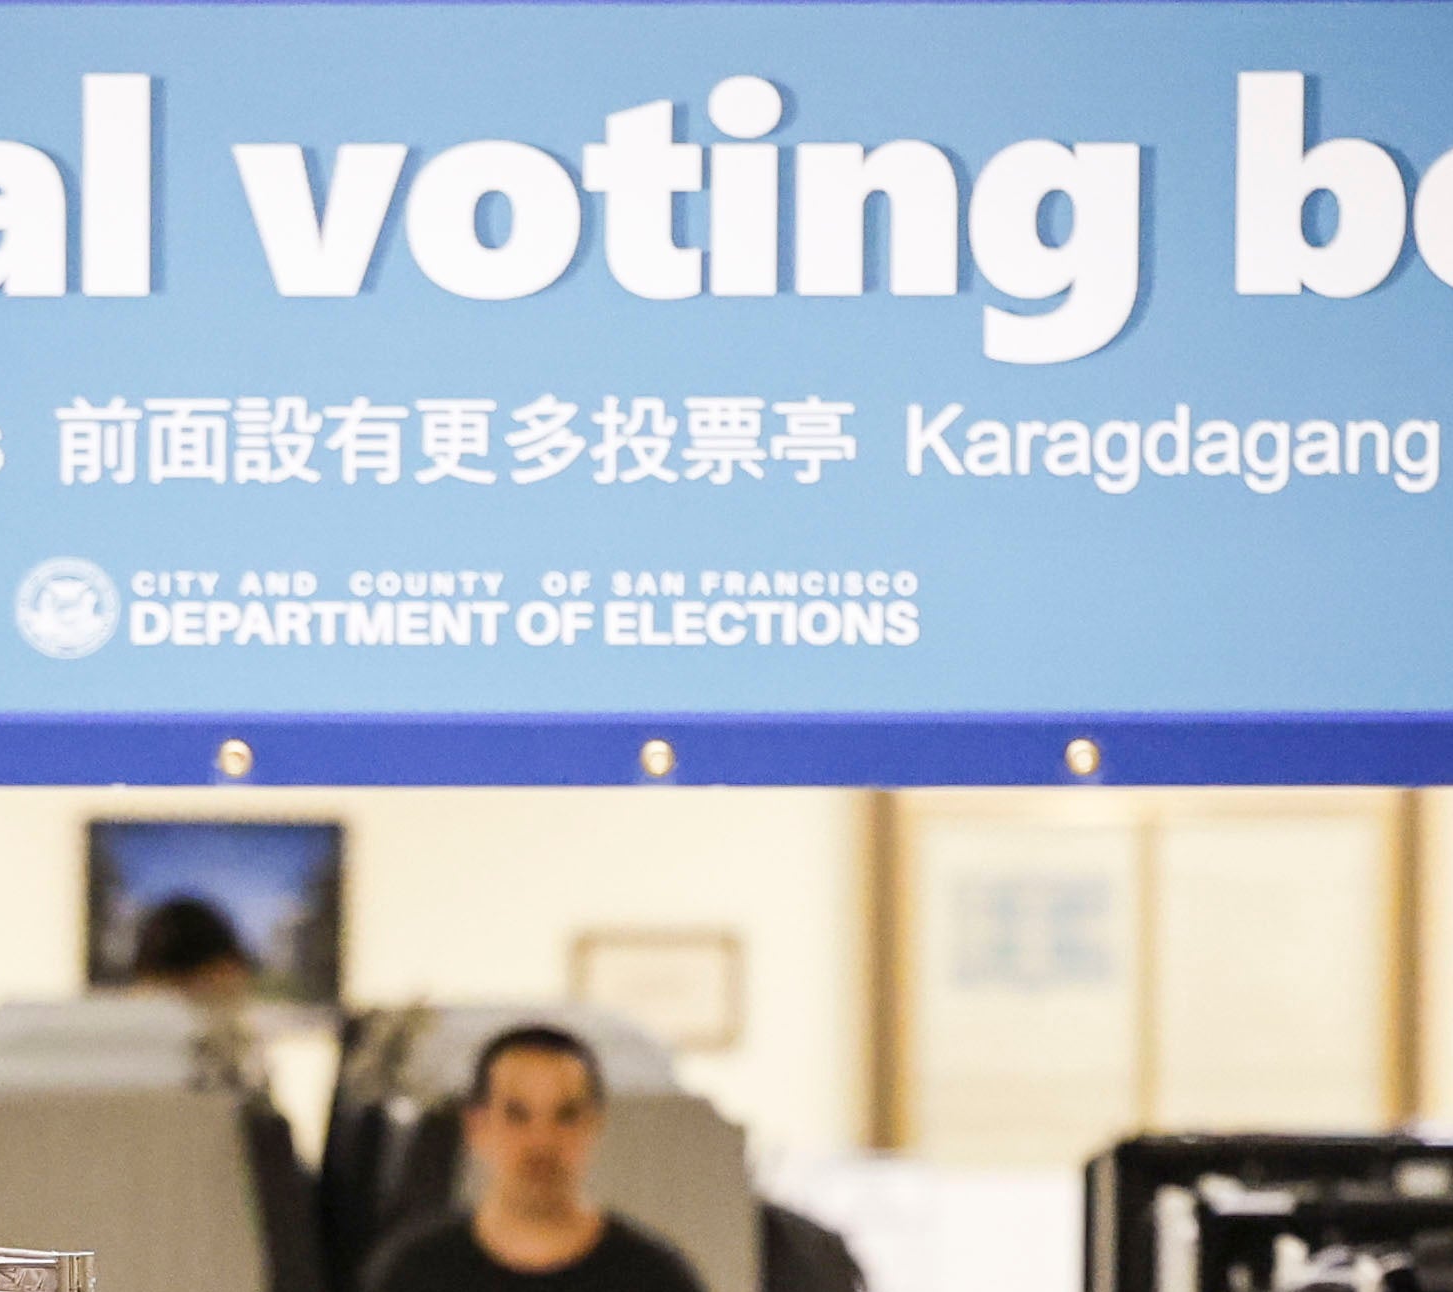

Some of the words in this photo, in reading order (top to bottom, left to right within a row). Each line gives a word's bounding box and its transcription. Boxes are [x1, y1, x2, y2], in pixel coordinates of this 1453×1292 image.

[231, 74, 1141, 366] voting
[52, 392, 859, 488] 前面設有更多投票亭
[905, 401, 1441, 497] Karagdagang
[129, 568, 221, 598] CITY
[237, 568, 319, 598] AND
[347, 568, 506, 598] COUNTY
[539, 569, 593, 598] OF
[609, 569, 687, 598] SAN
[698, 568, 921, 598] FRANCISCO
[129, 599, 511, 648] DEPARTMENT
[515, 600, 596, 648] OF
[602, 598, 921, 648] ELECTIONS
